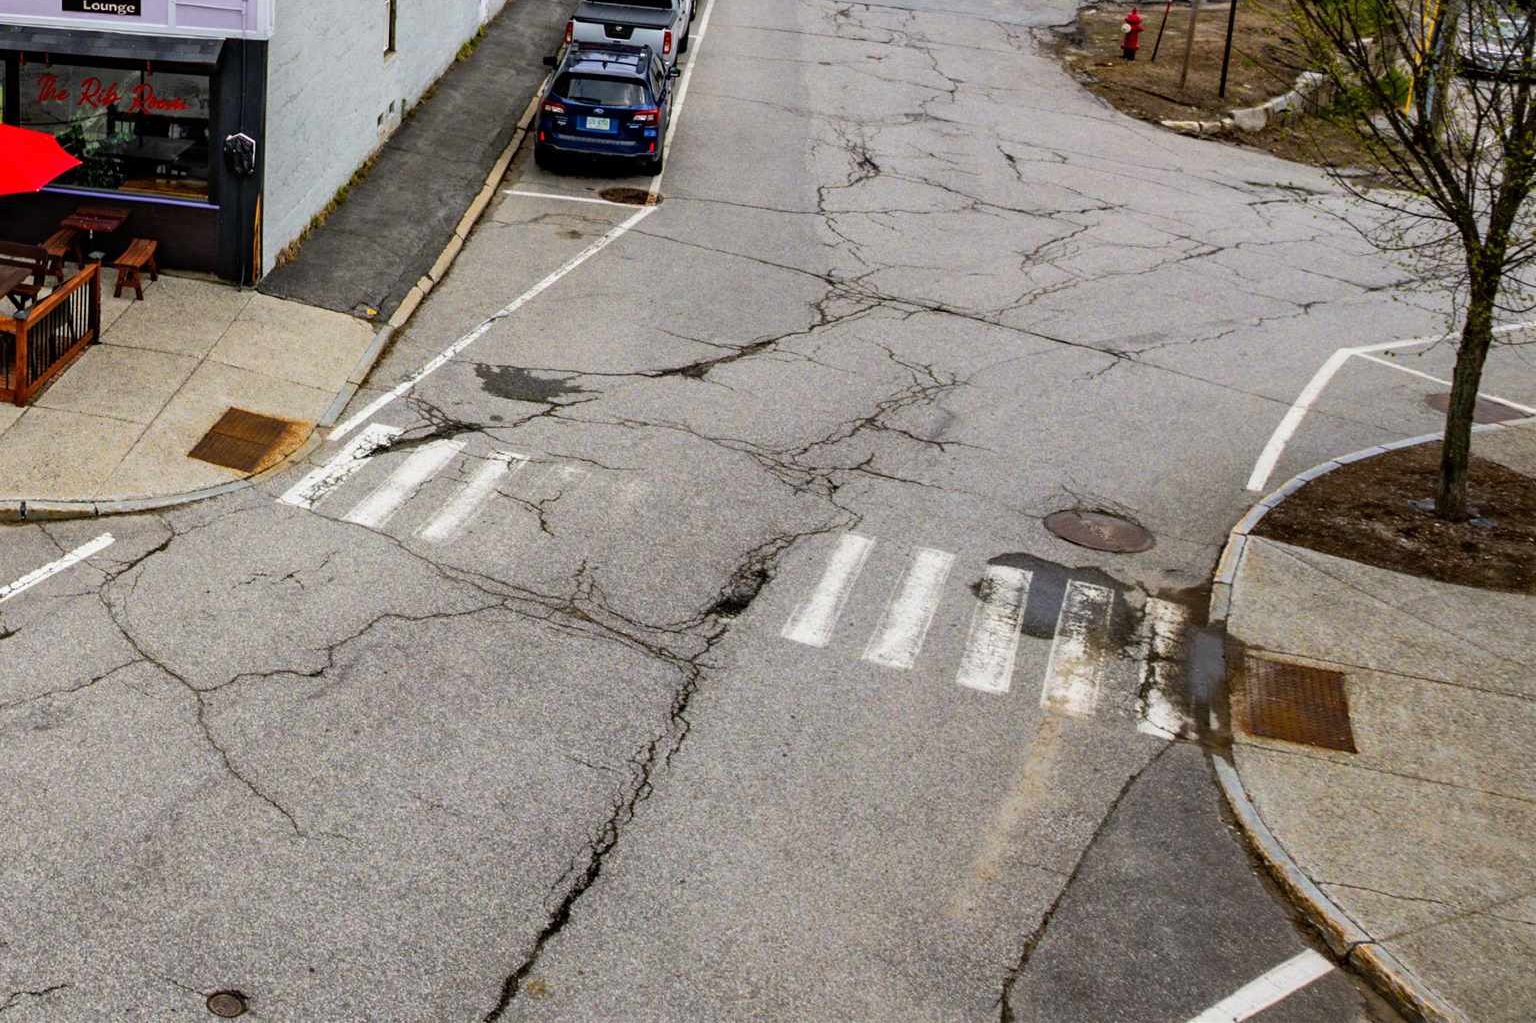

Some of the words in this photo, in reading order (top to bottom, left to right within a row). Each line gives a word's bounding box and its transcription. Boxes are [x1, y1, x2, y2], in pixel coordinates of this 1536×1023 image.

[83, 0, 136, 15] Lounge
[37, 74, 70, 103] The
[78, 77, 122, 108] Rib
[128, 83, 191, 113] Room
